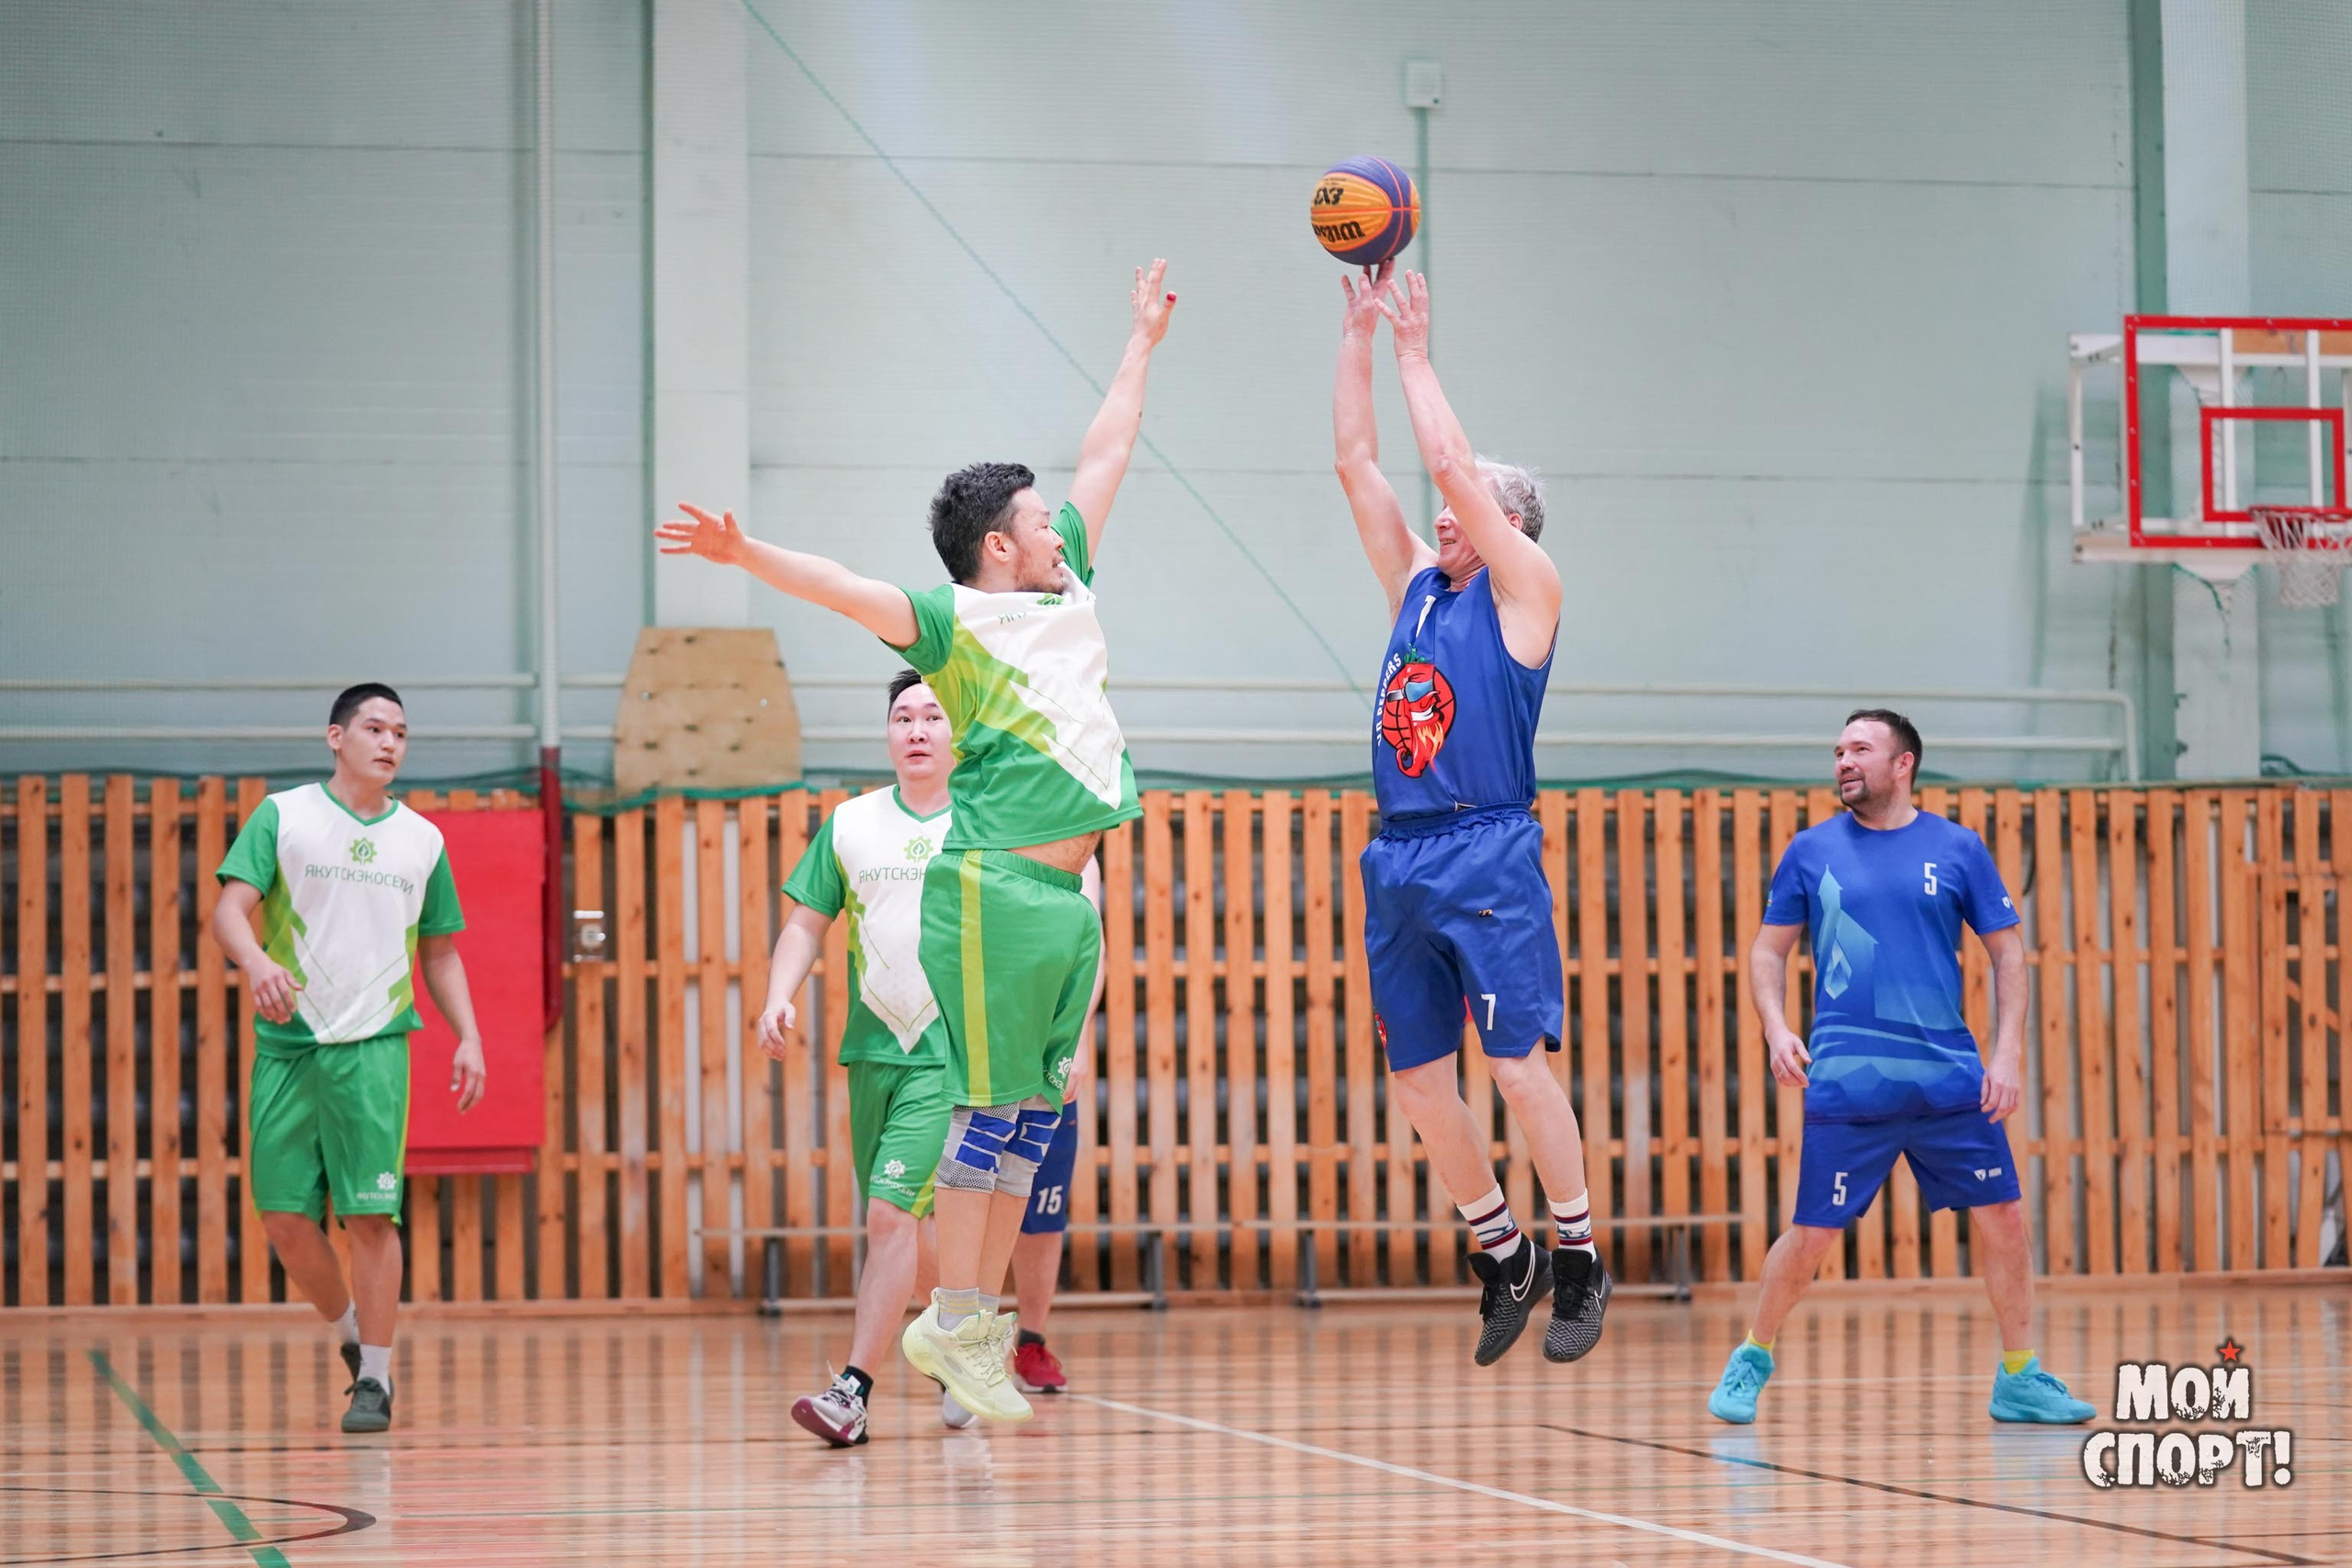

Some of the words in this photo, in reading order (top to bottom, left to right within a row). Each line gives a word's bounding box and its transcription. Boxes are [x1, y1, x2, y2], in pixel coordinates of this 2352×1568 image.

[304, 863, 414, 896] ЯКУТСКЭКОСЕТИ
[1924, 862, 1938, 896] 5
[1480, 993, 1497, 1031] 7
[1036, 1185, 1063, 1214] 15
[1832, 1171, 1849, 1206] 5
